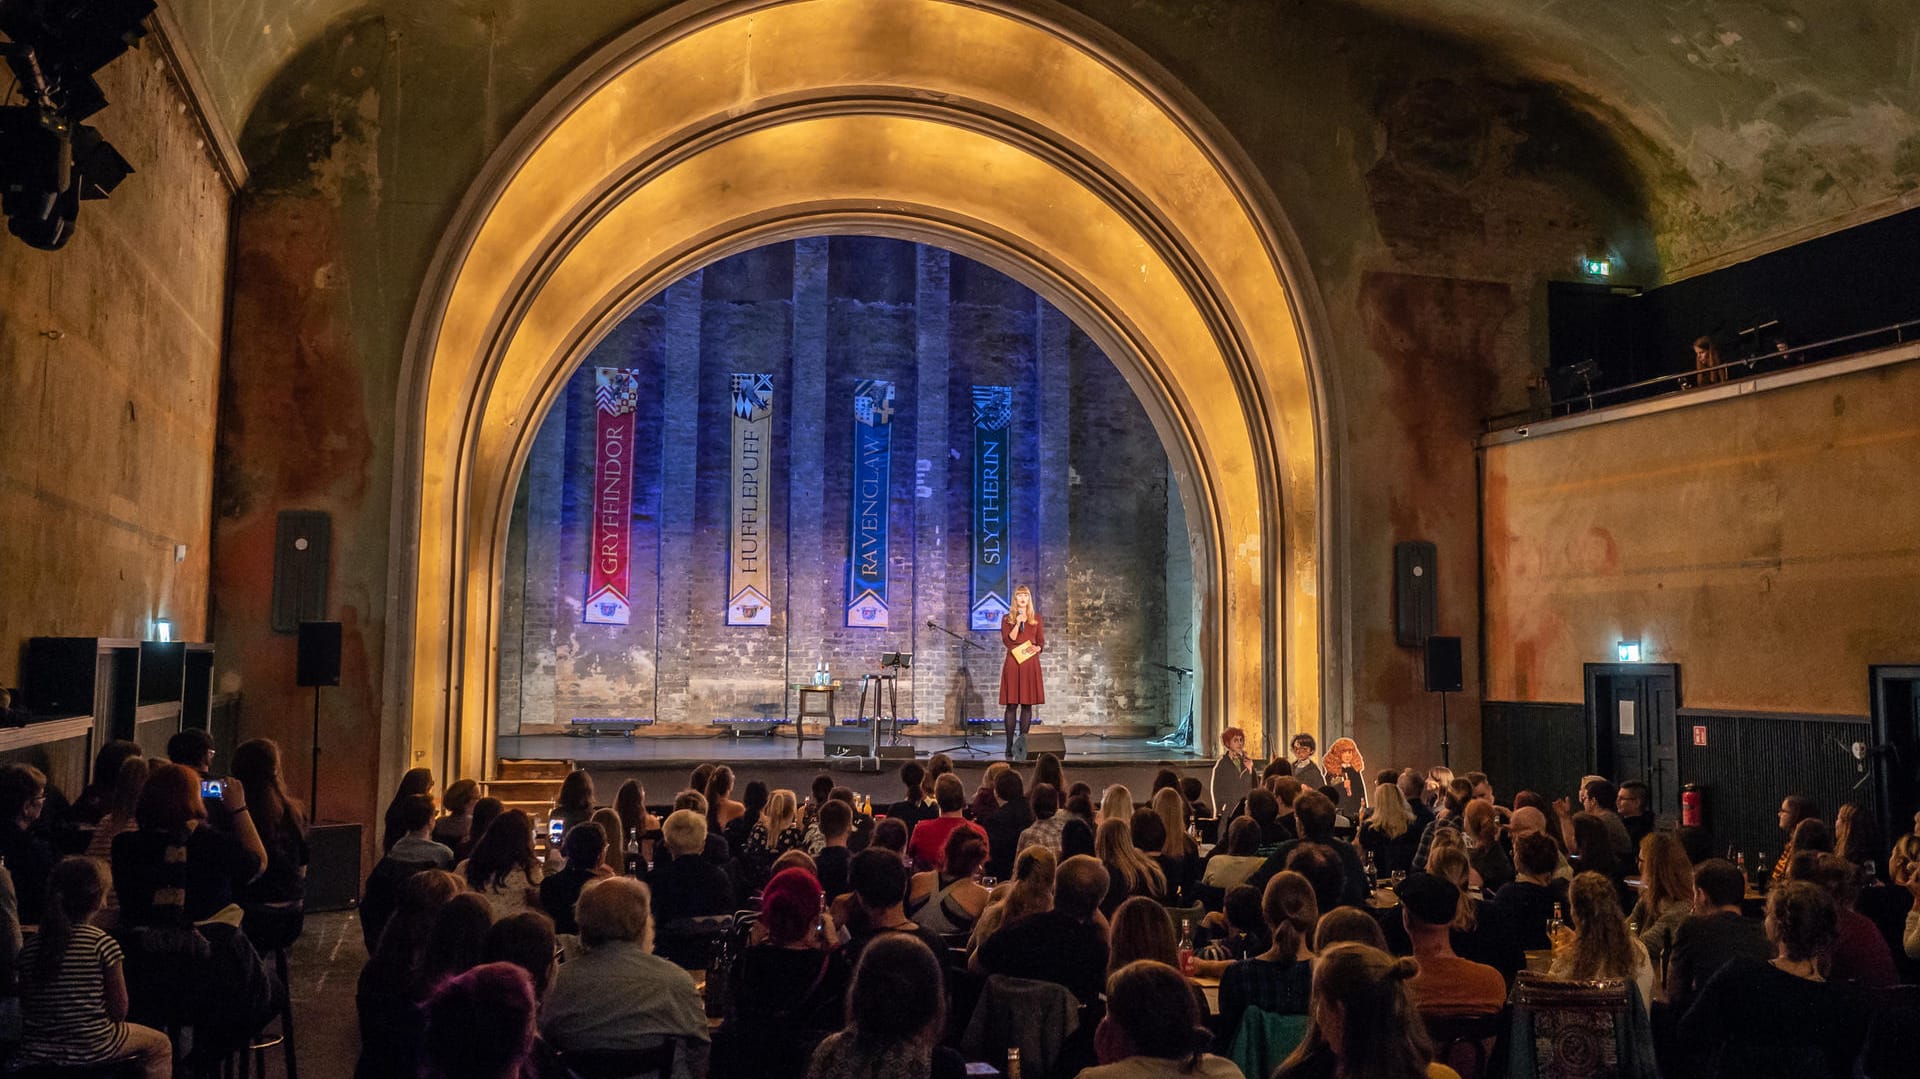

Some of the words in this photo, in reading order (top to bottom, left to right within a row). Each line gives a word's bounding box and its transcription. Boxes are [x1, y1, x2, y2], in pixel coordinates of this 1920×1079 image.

[601, 425, 624, 574] GRYFFINDOR
[742, 430, 759, 573] HUFFLEPUFF
[862, 435, 880, 576] RAVENCLAW
[983, 440, 1000, 565] SLYTHERIN
